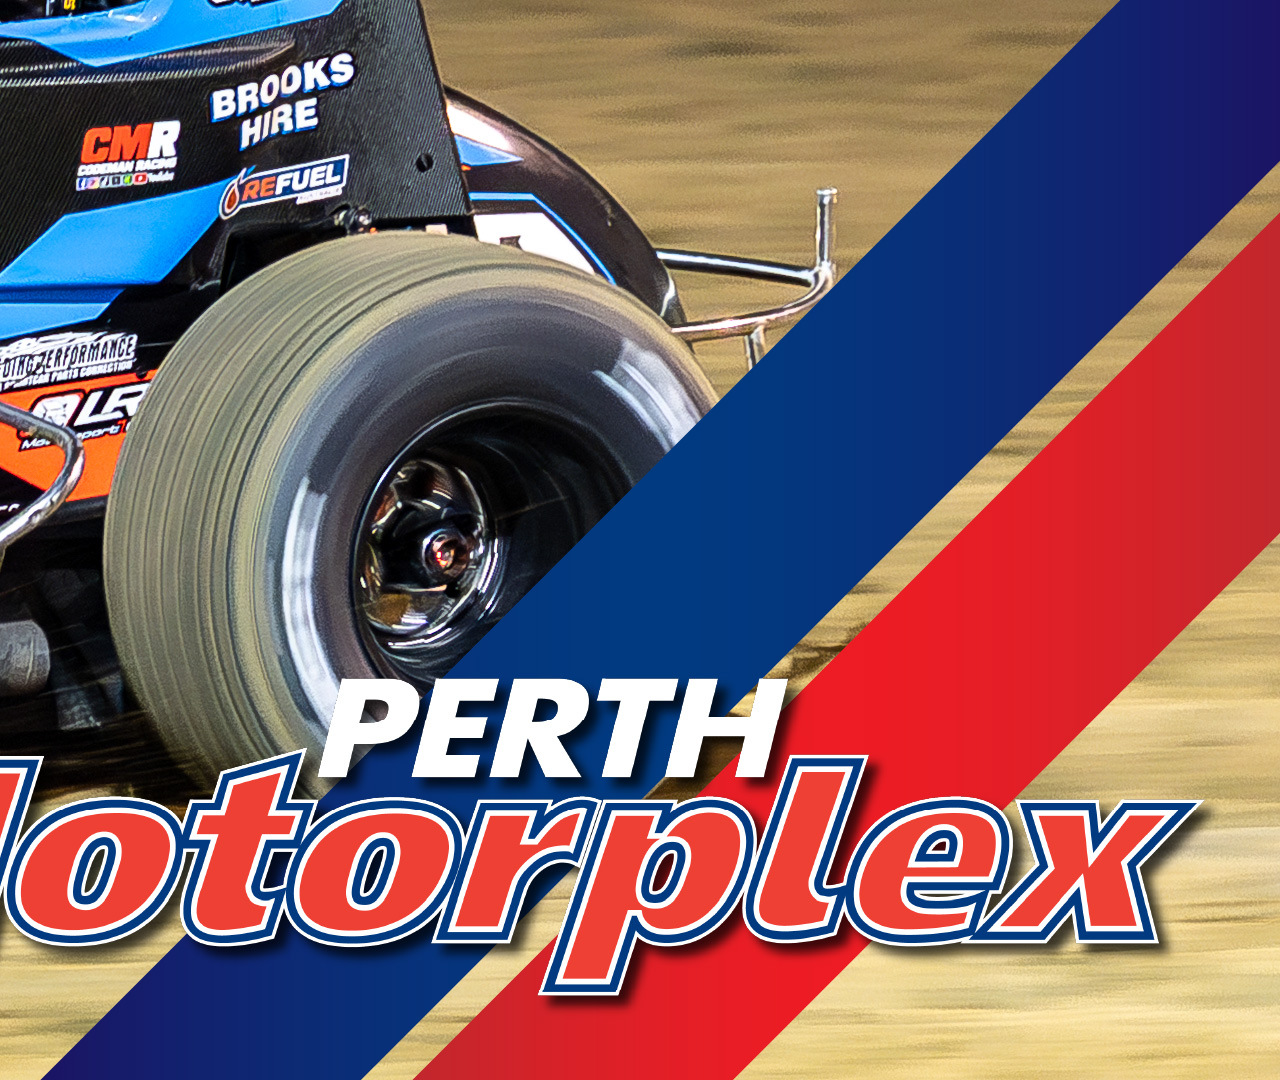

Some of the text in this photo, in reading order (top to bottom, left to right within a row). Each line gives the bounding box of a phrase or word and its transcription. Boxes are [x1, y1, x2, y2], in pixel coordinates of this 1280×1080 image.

[210, 53, 354, 122] BROOKS
[81, 120, 180, 163] CMR
[240, 98, 319, 151] HIRE
[242, 163, 341, 202] REFUEL
